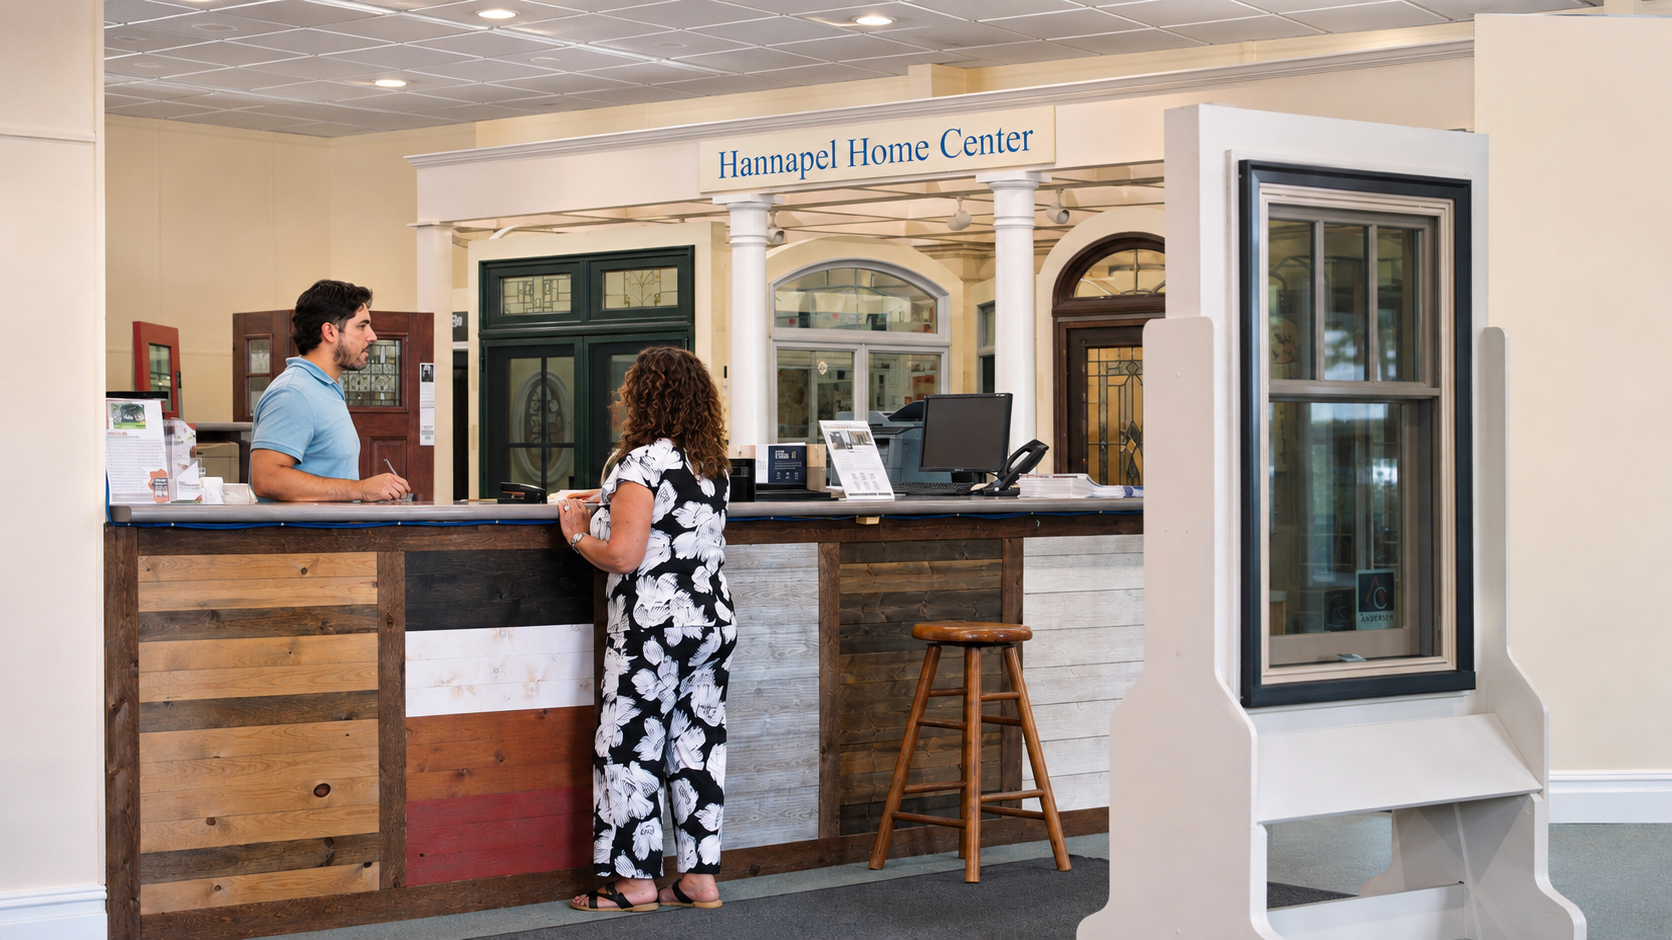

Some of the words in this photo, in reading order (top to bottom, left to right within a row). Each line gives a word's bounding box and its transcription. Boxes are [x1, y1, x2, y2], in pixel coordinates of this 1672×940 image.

[718, 139, 838, 179] Hannapel
[847, 138, 930, 167] Home
[940, 128, 1034, 159] Center
